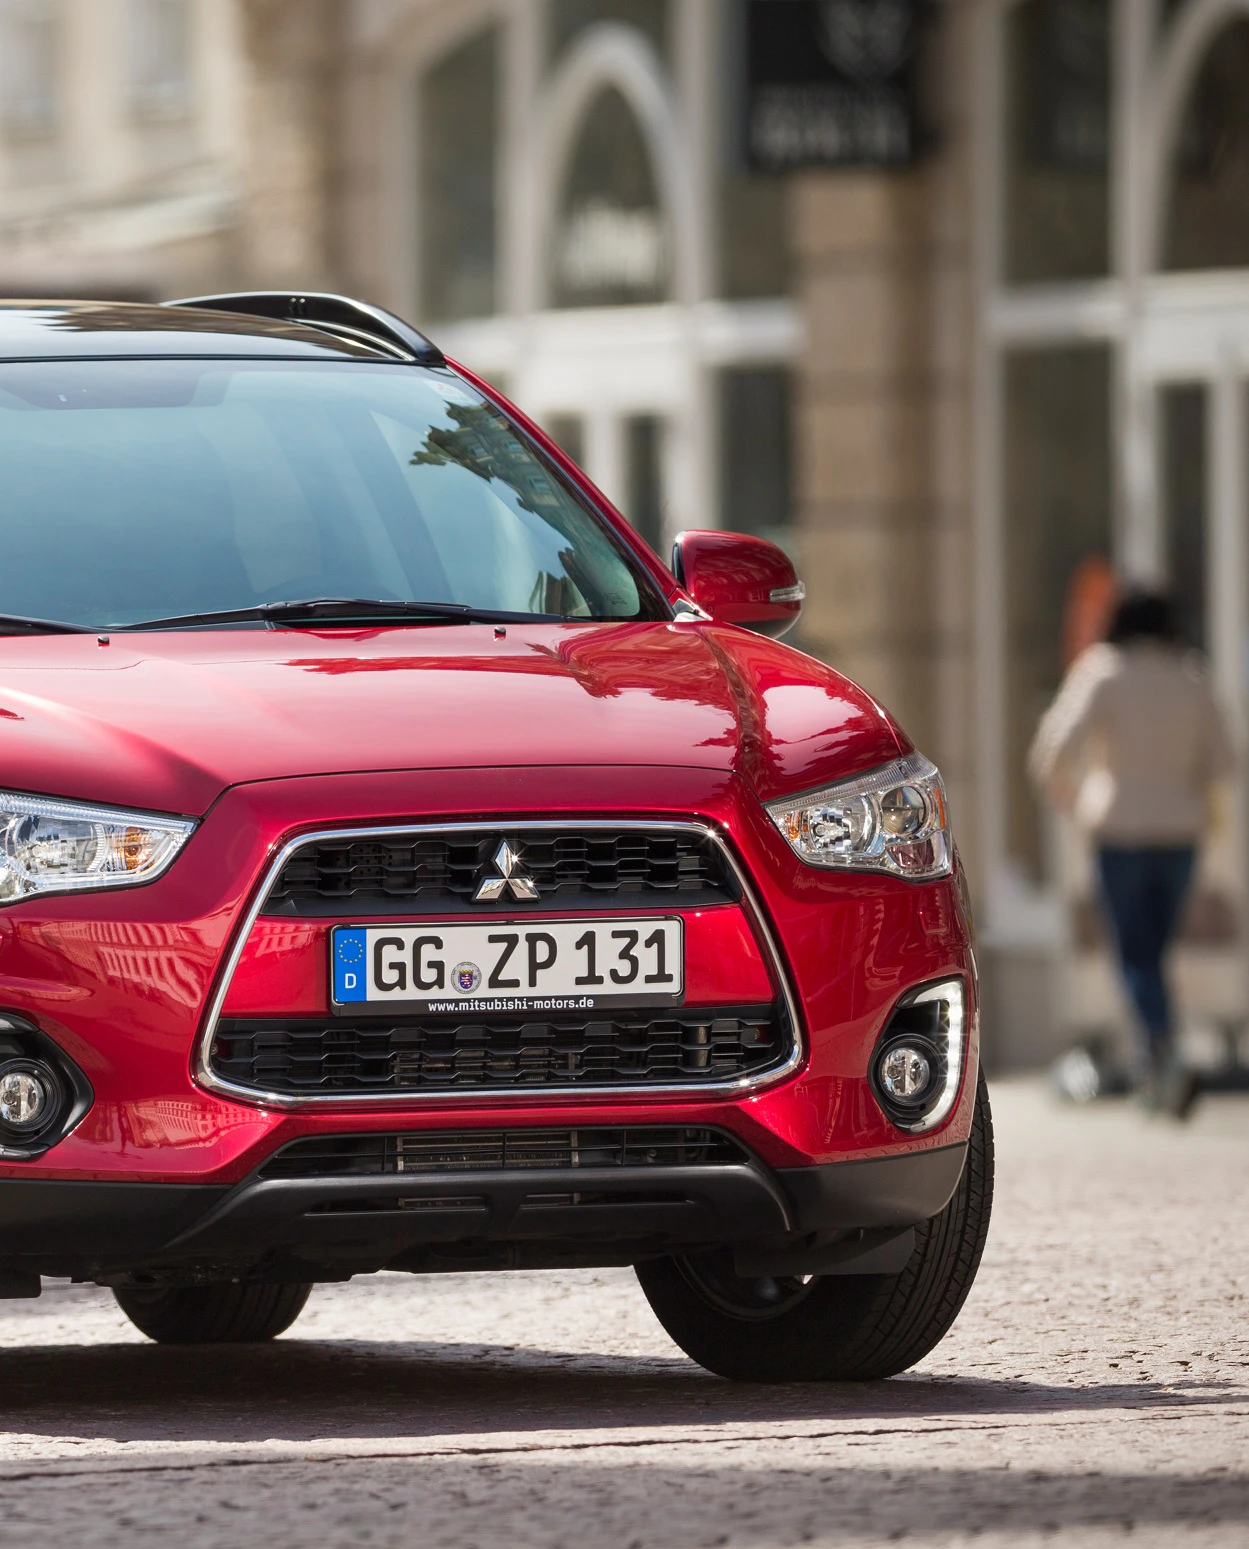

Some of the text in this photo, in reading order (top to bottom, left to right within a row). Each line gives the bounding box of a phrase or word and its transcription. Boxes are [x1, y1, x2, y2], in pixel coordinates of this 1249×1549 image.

[373, 936, 445, 992] GG
[488, 932, 558, 989] ZP
[575, 928, 674, 986] 131
[344, 973, 357, 989] D
[428, 996, 594, 1012] www.mitsubishi-motors.de
